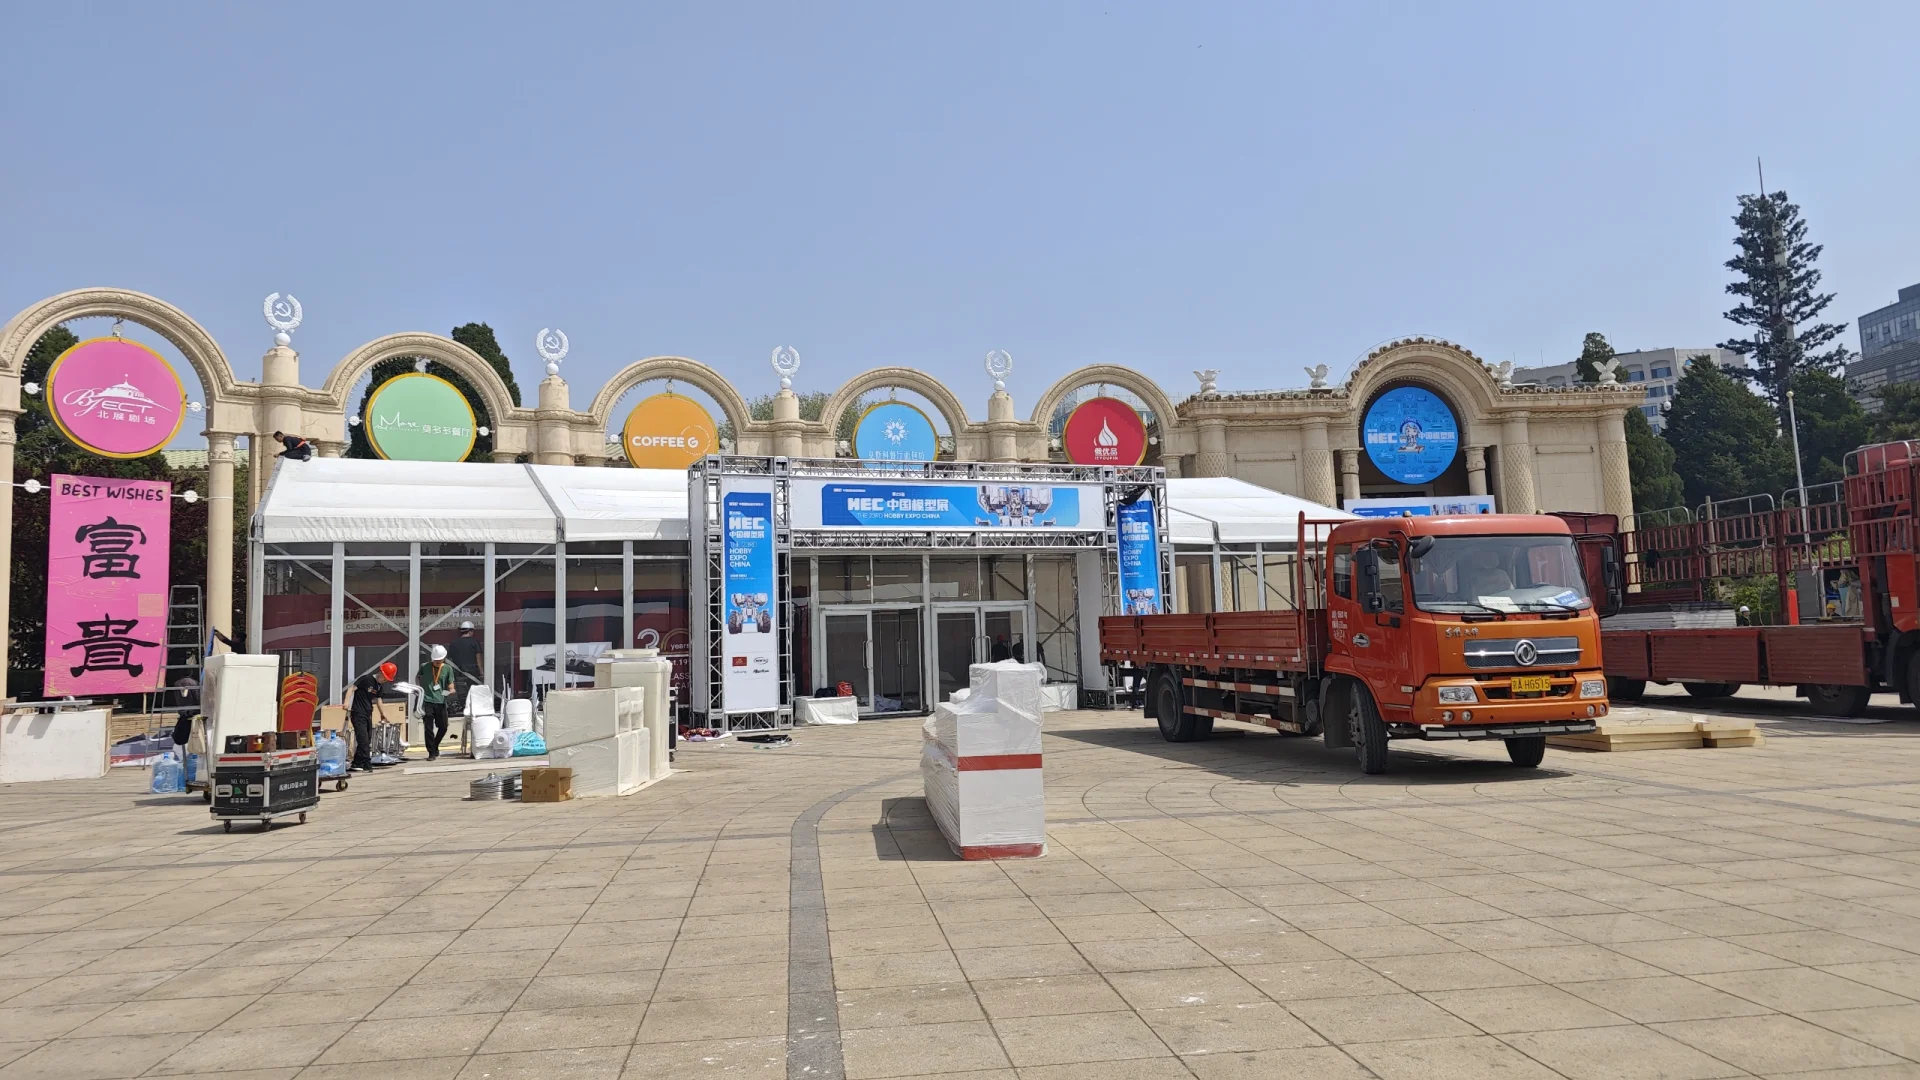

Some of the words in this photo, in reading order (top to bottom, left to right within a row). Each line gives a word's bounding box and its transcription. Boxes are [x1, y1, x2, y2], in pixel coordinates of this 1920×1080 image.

[97, 410, 155, 425] 北展剧场
[422, 424, 471, 437] 莫多多餐厅
[632, 436, 685, 448] COFFEE
[687, 437, 699, 448] G
[61, 483, 100, 497] BEST
[107, 487, 164, 501] WISHES
[847, 498, 884, 511] HEC
[887, 498, 949, 511] 中国模型展
[729, 517, 764, 530] HEC
